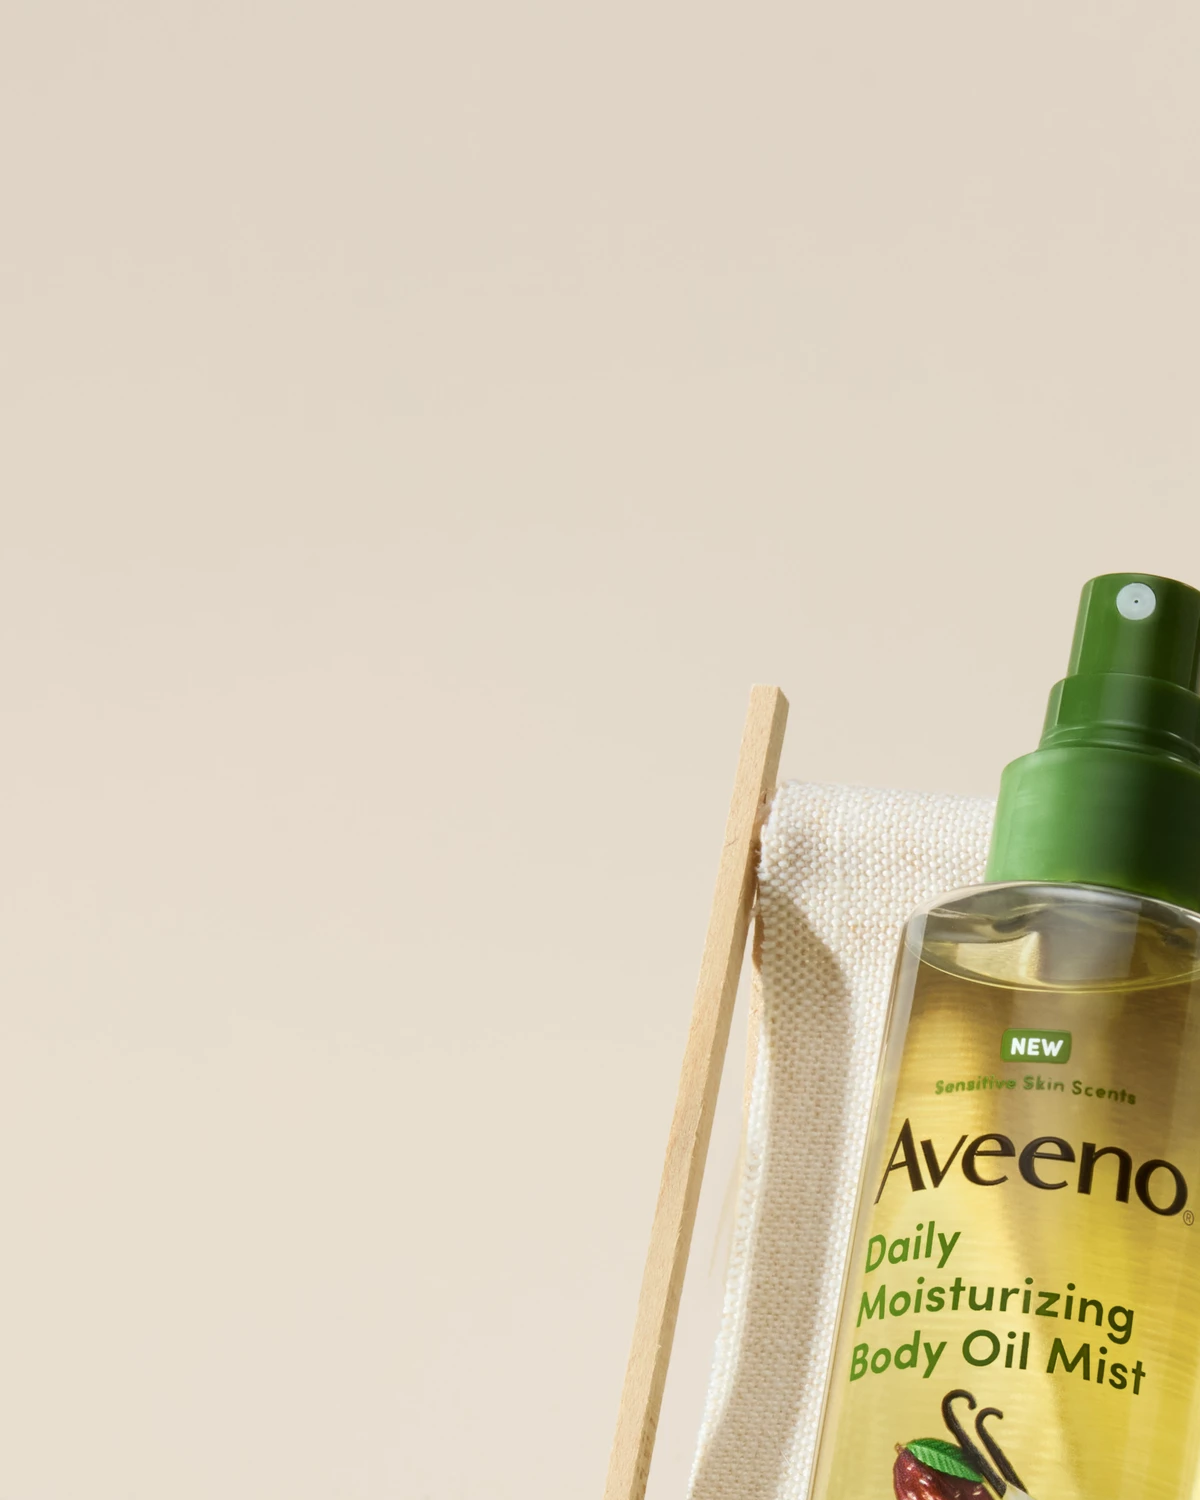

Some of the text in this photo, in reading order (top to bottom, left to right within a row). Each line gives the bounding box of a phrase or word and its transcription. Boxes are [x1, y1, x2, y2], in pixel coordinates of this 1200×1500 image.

[1010, 1037, 1064, 1058] NEW
[934, 1074, 1137, 1105] Sensitive Skin Scents
[873, 1117, 1189, 1217] Aveeno
[865, 1220, 962, 1274] Daily
[856, 1276, 1135, 1345] Moisturizing
[850, 1329, 1146, 1395] Body Oil Mist
